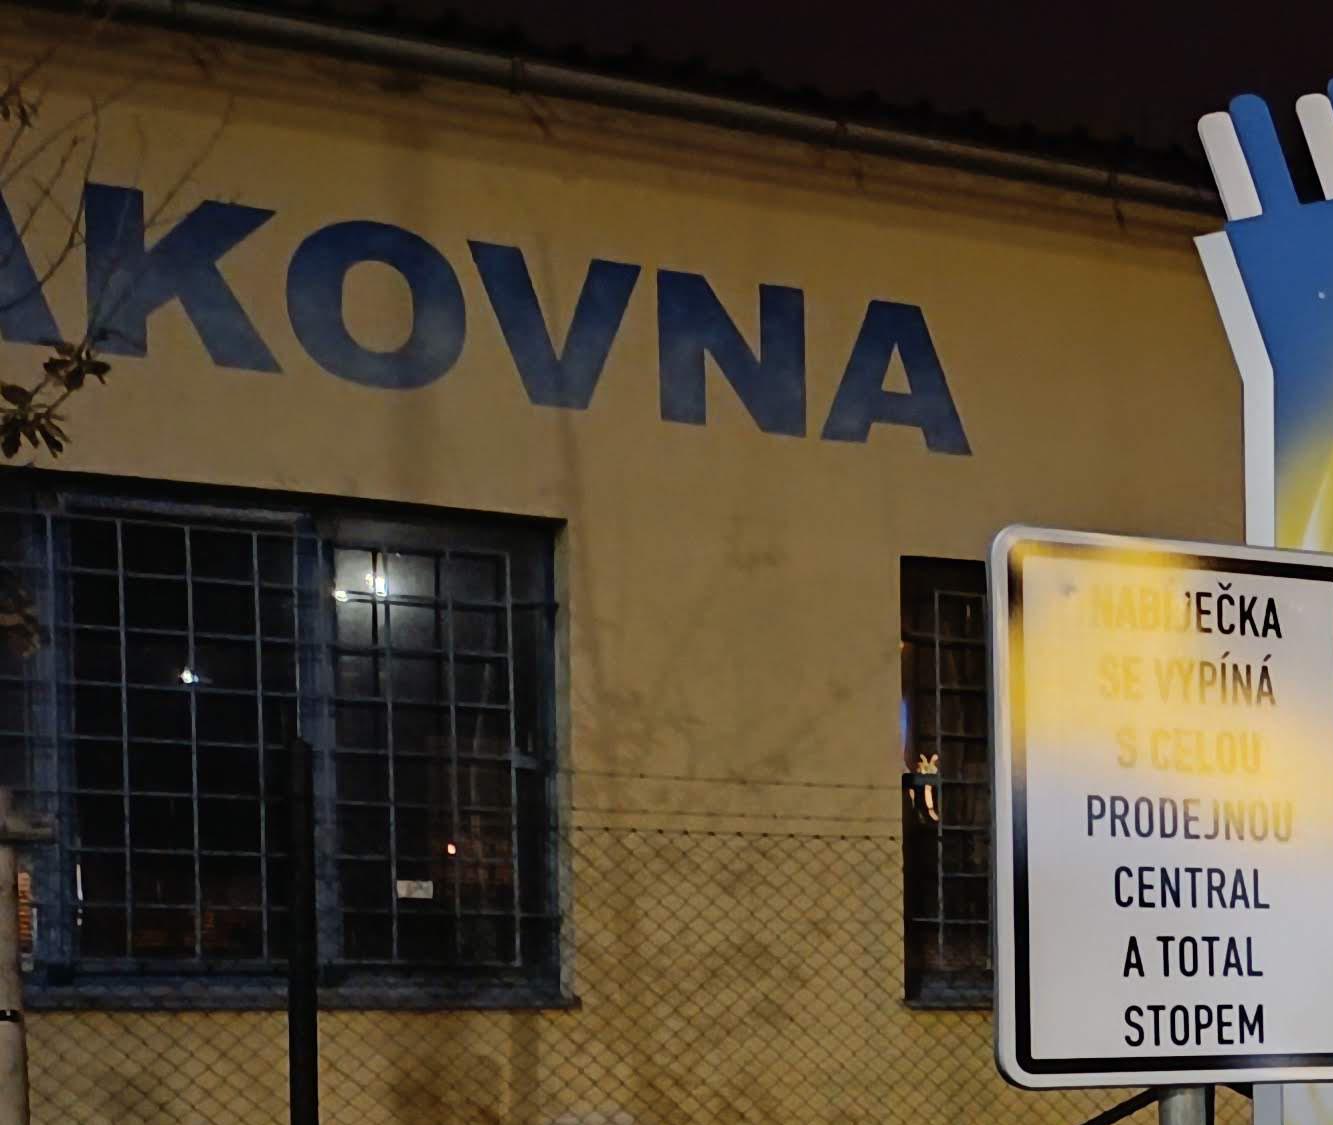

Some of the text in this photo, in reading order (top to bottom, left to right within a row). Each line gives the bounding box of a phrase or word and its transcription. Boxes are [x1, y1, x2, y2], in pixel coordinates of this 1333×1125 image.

[1099, 651, 1277, 706] SE VYPÍNÁ
[1117, 724, 1265, 777] S CELOU
[1087, 795, 1294, 842] PRODEJNOU
[1114, 866, 1270, 909] CENTRAL
[1123, 935, 1264, 977] A TOTAL
[1124, 1004, 1264, 1047] STOPEM
